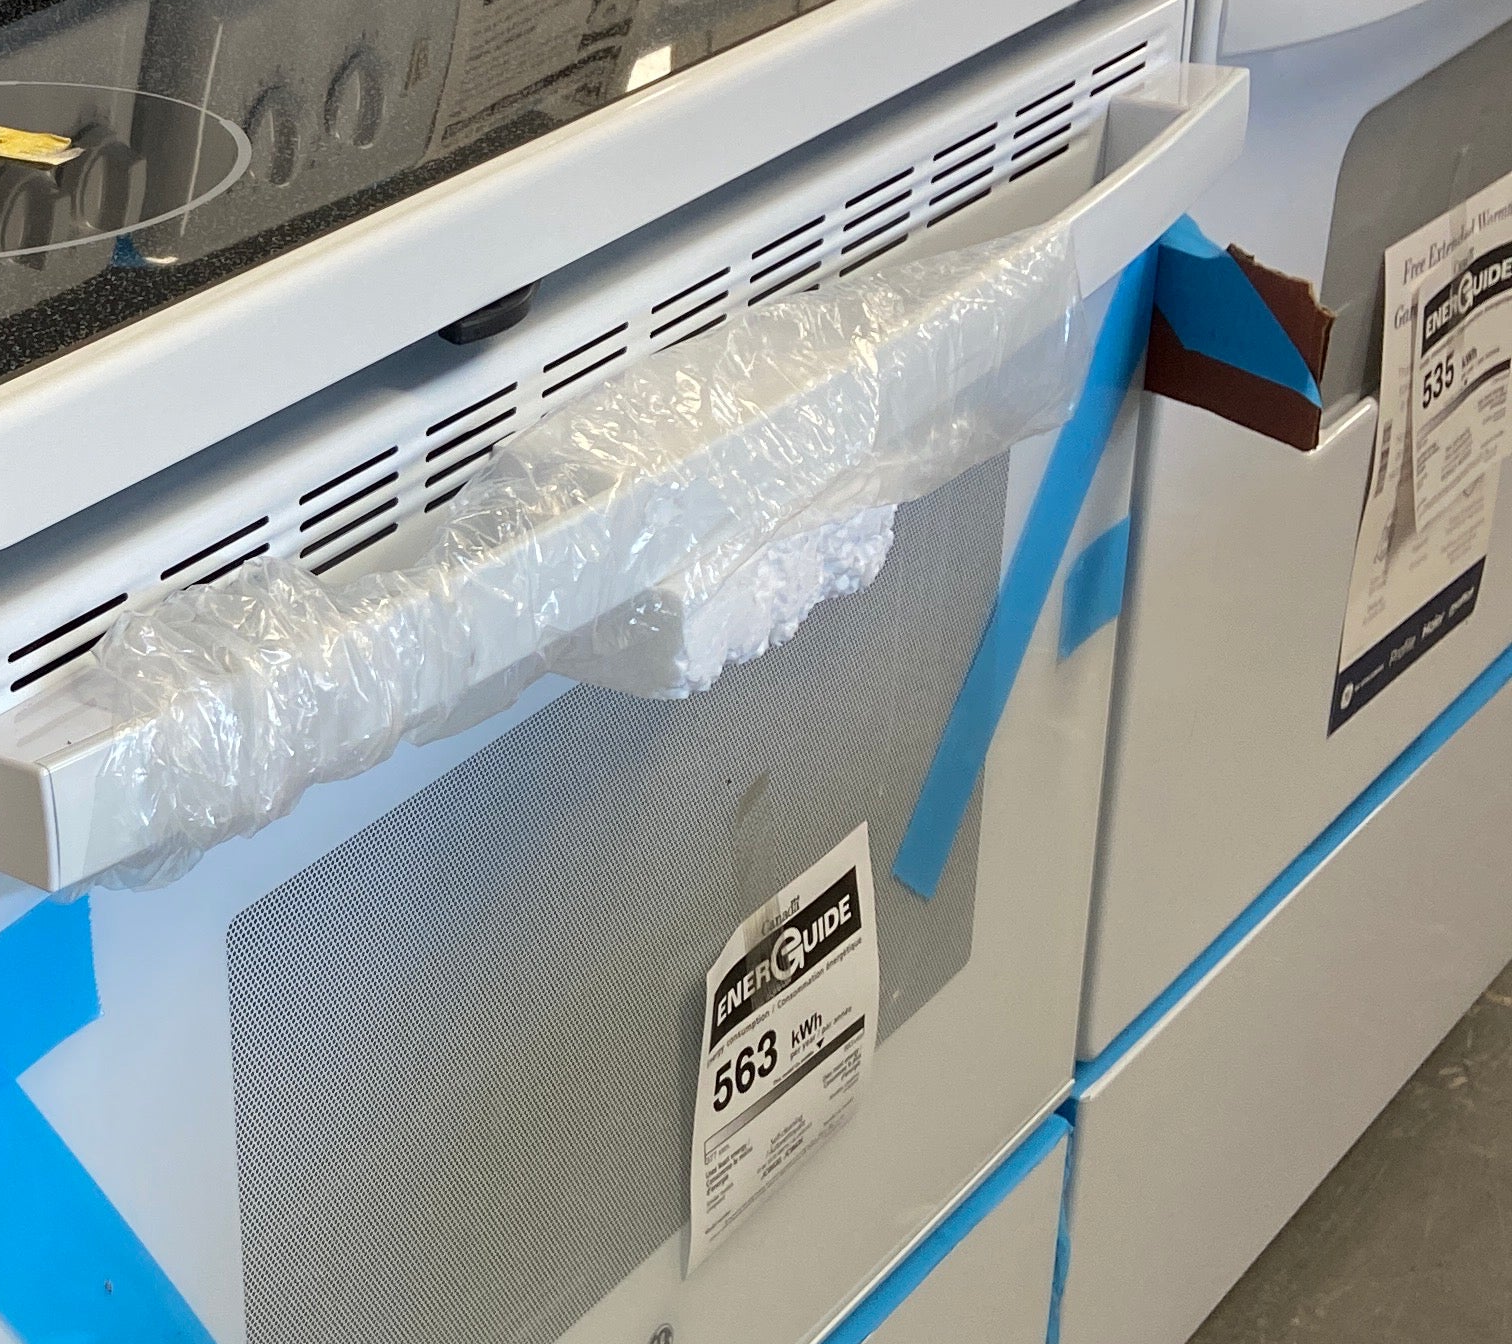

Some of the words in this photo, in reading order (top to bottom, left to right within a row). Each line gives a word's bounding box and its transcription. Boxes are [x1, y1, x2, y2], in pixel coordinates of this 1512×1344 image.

[1422, 349, 1455, 409] 535
[726, 1009, 771, 1048] consumption
[712, 1029, 778, 1113] 563
[791, 1011, 823, 1049] kWh
